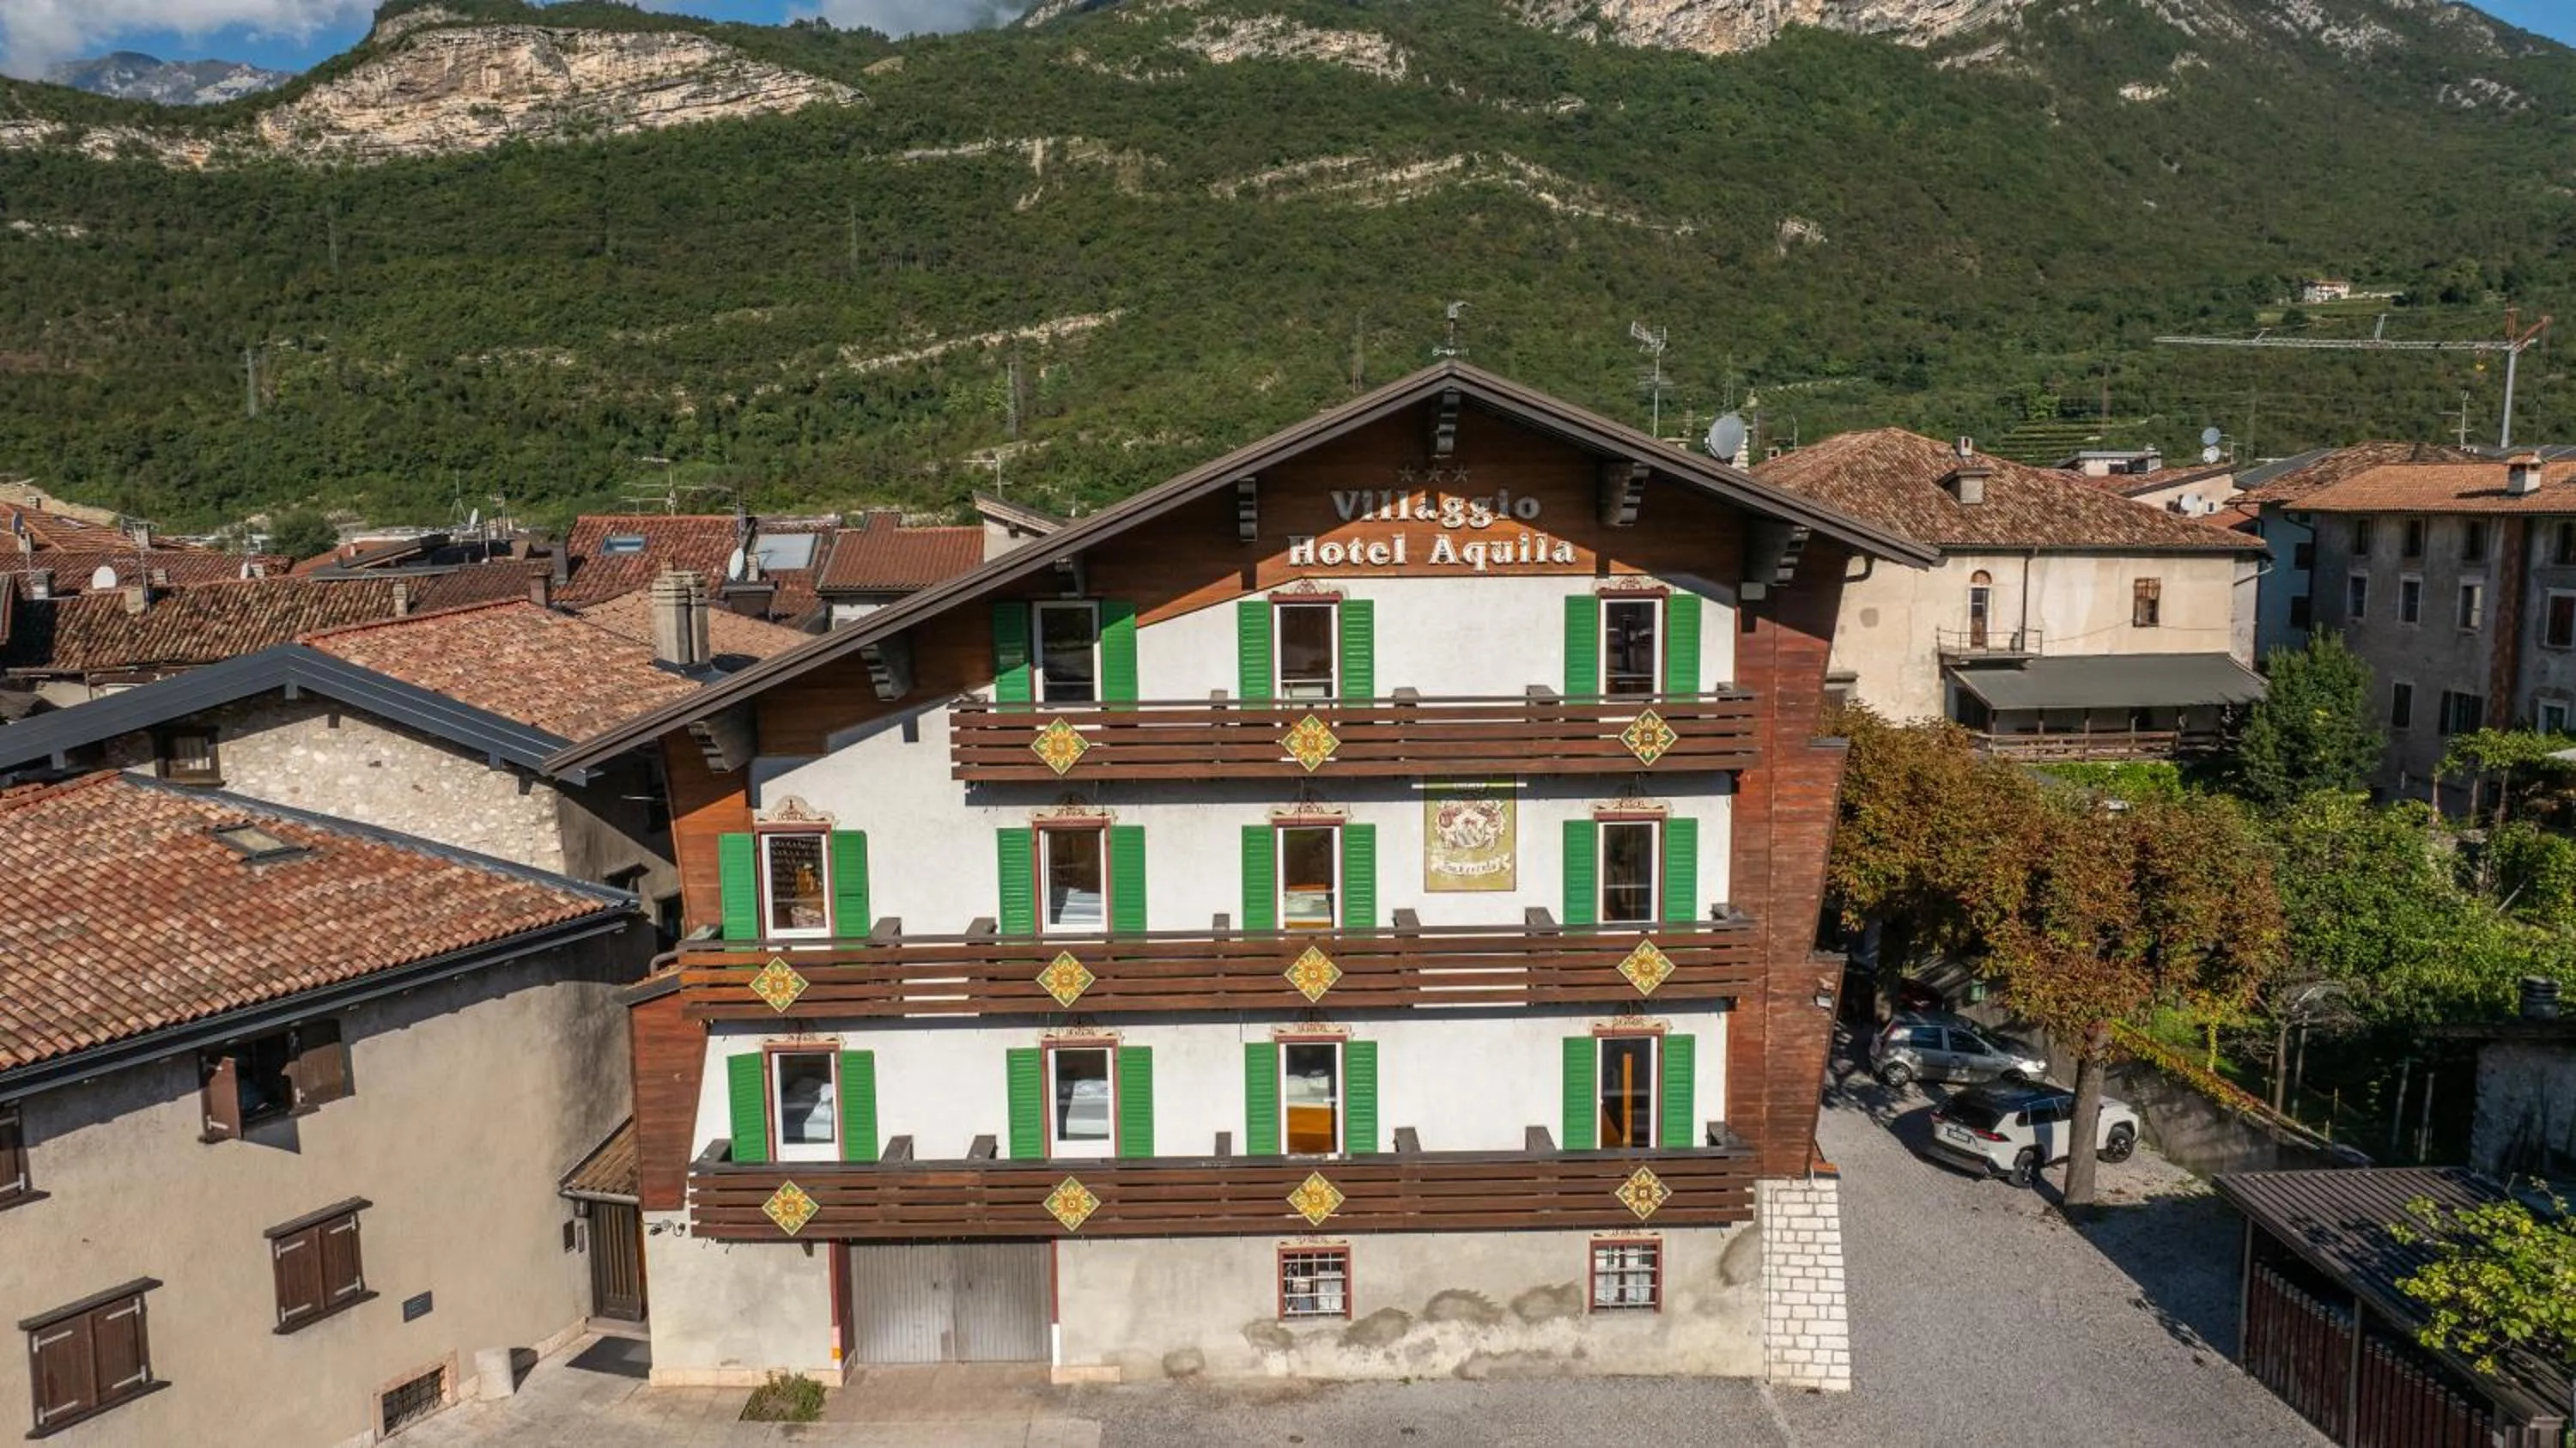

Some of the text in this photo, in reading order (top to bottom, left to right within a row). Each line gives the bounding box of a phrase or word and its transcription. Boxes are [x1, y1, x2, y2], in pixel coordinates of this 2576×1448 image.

[1331, 489, 1540, 529] Villaggio
[1289, 532, 1577, 571] Hotel Aquila
